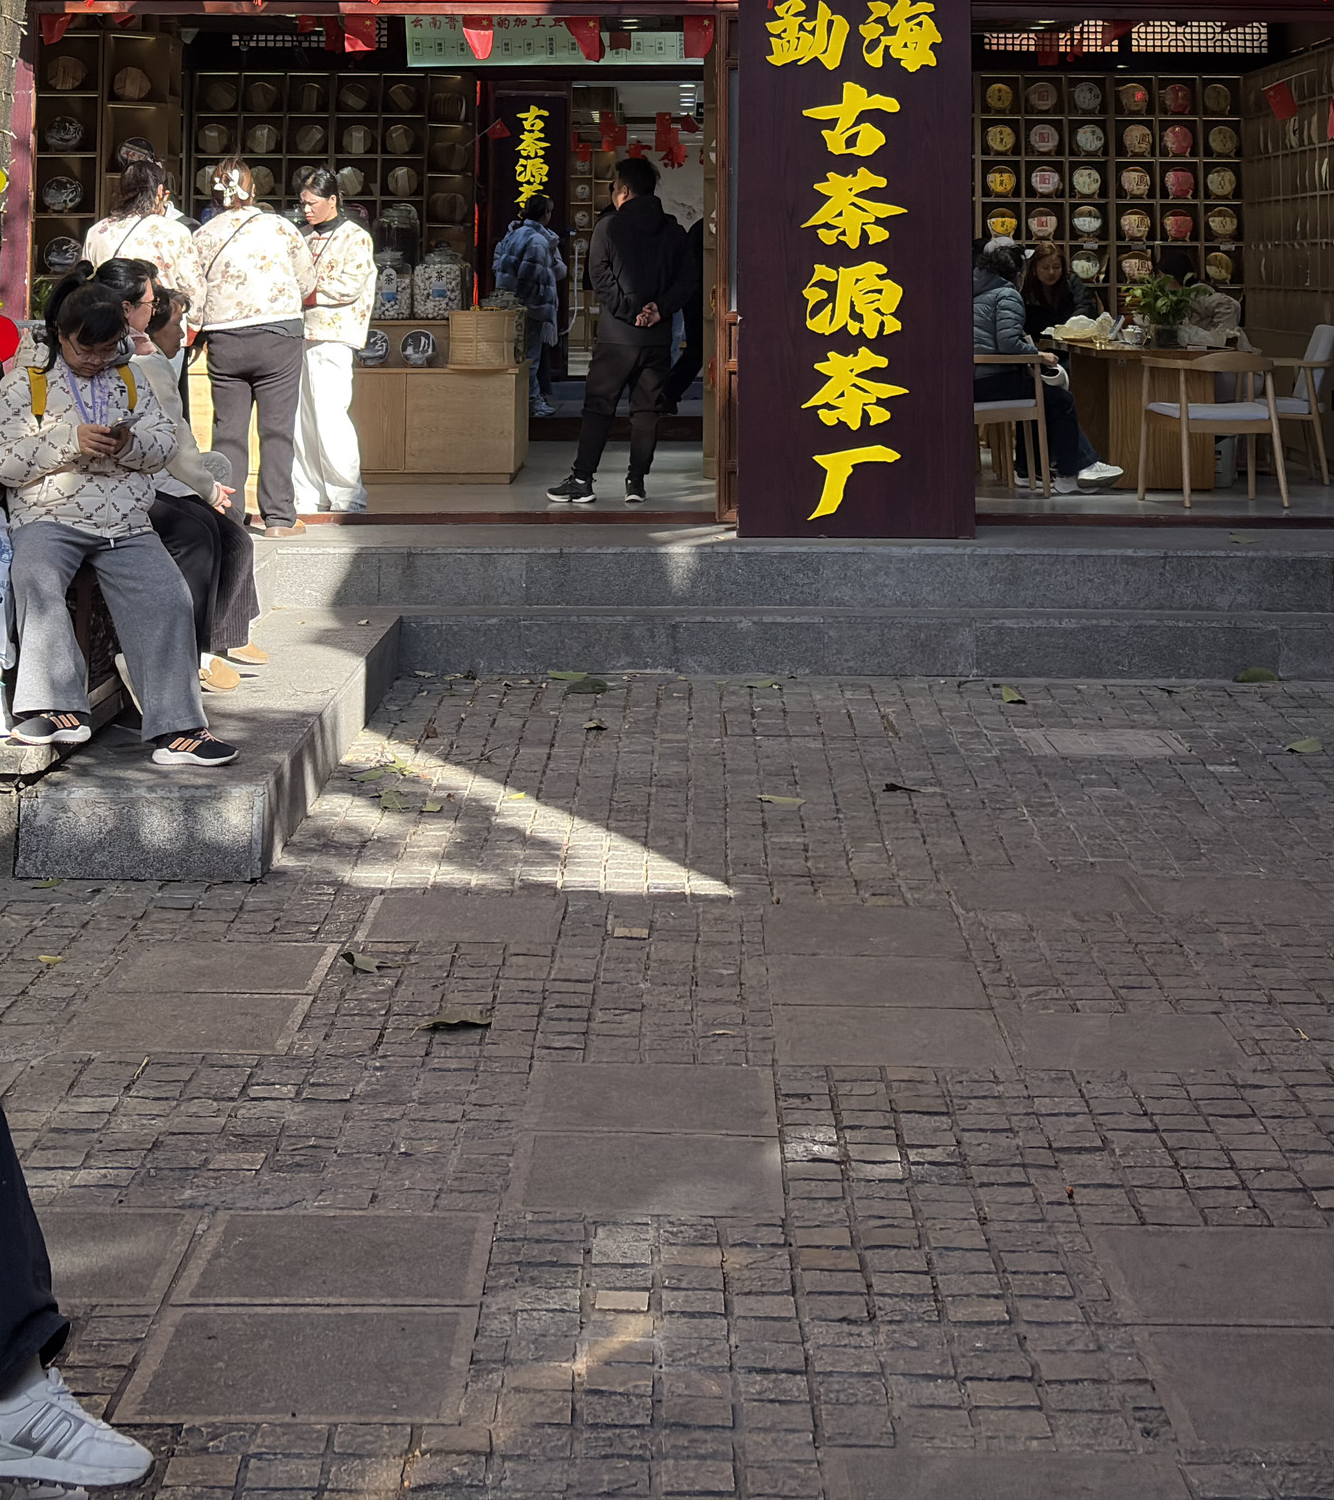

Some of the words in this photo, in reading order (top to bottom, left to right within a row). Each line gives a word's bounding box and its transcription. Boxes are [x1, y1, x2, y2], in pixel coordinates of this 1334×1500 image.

[384, 274, 393, 285] 茶
[435, 271, 444, 282] 茶
[800, 81, 910, 521] 古茶源茶厂
